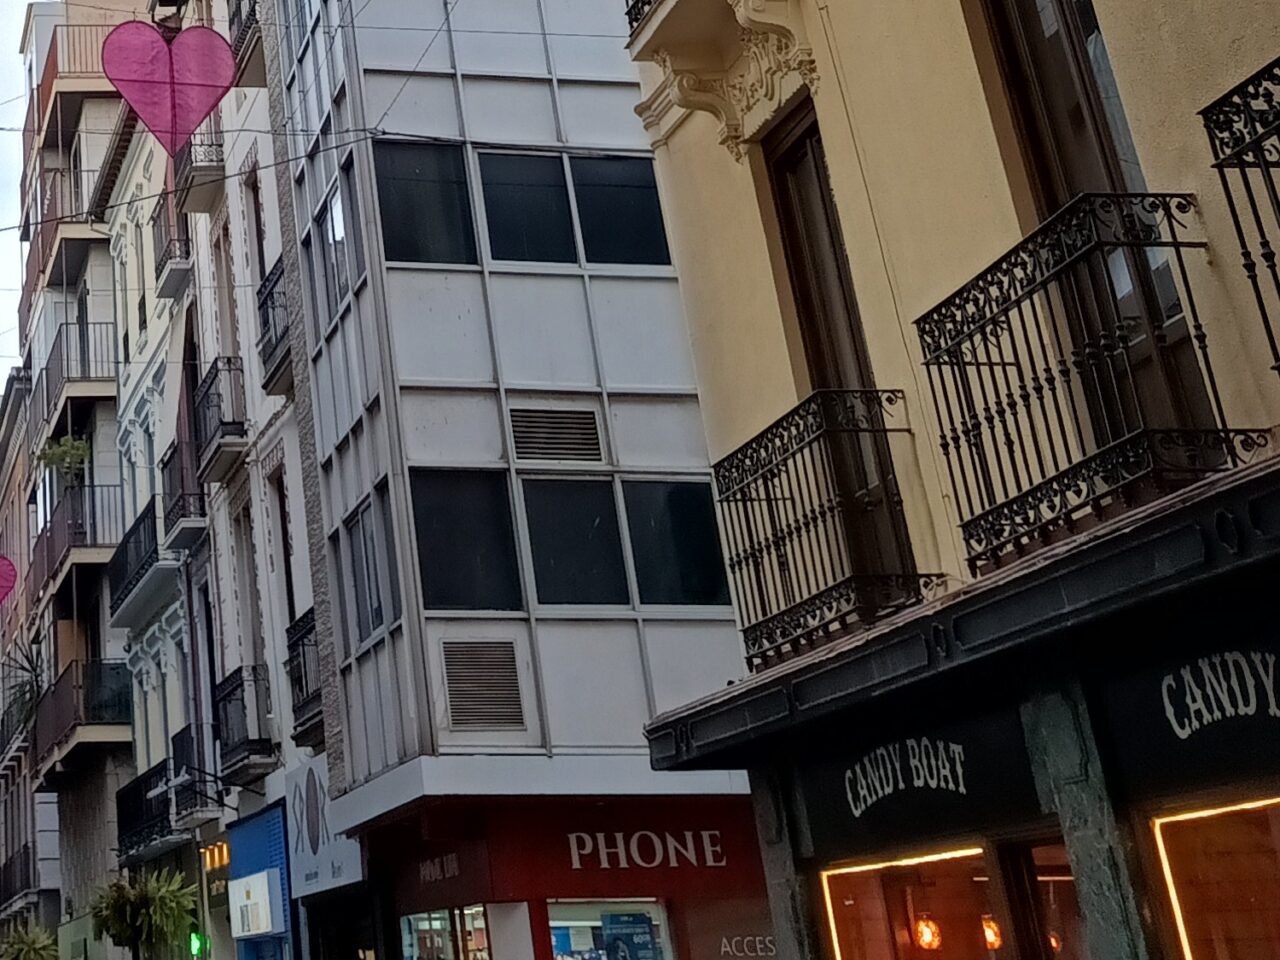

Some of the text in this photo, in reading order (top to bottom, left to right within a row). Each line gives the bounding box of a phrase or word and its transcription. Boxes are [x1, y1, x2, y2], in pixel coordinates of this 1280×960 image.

[1161, 651, 1280, 739] CANDY
[845, 737, 967, 817] CANDY BOAT
[569, 831, 726, 869] PHONE
[721, 937, 776, 956] ACCES
